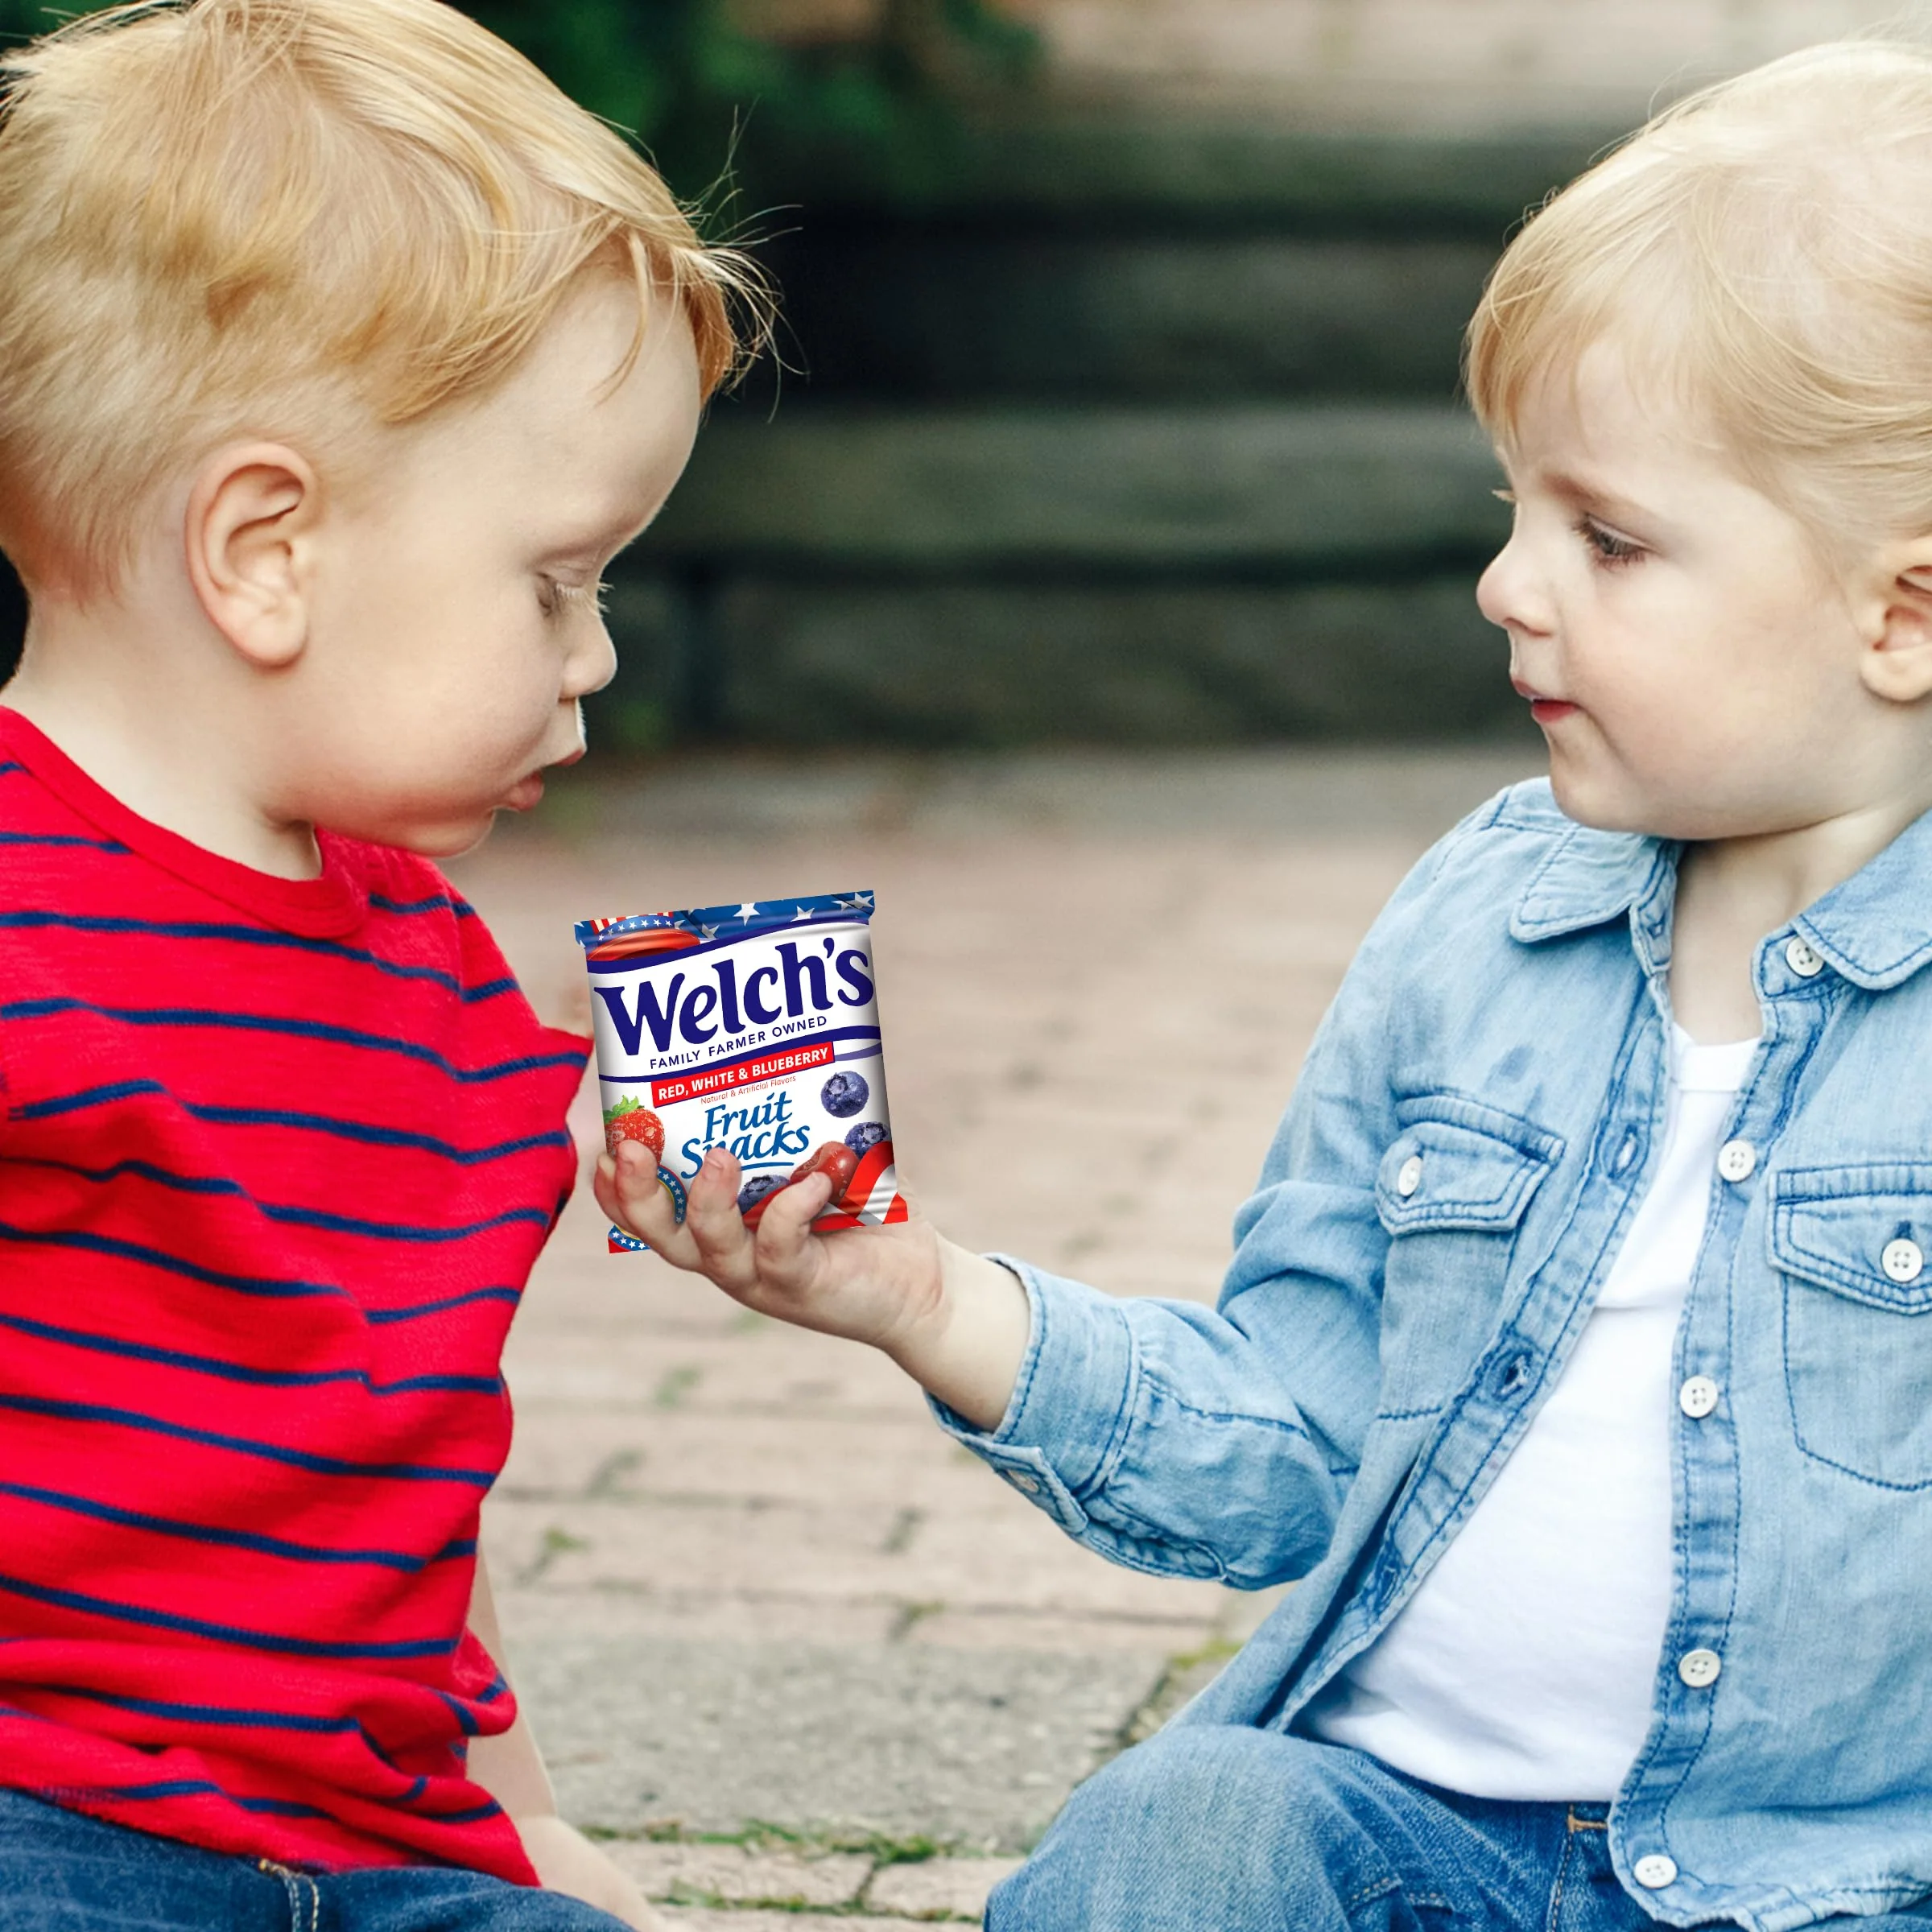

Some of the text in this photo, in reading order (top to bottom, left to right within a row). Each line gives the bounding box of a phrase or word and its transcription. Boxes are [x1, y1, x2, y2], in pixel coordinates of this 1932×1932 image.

[594, 937, 874, 1056] Welch's
[650, 1016, 828, 1069] FAMILY FARMER OWNED
[658, 1047, 828, 1100] RED, WHITE & BLUEBERRY
[700, 1075, 796, 1104] Natural & Artificial Flavors
[703, 1091, 793, 1144] Fruit
